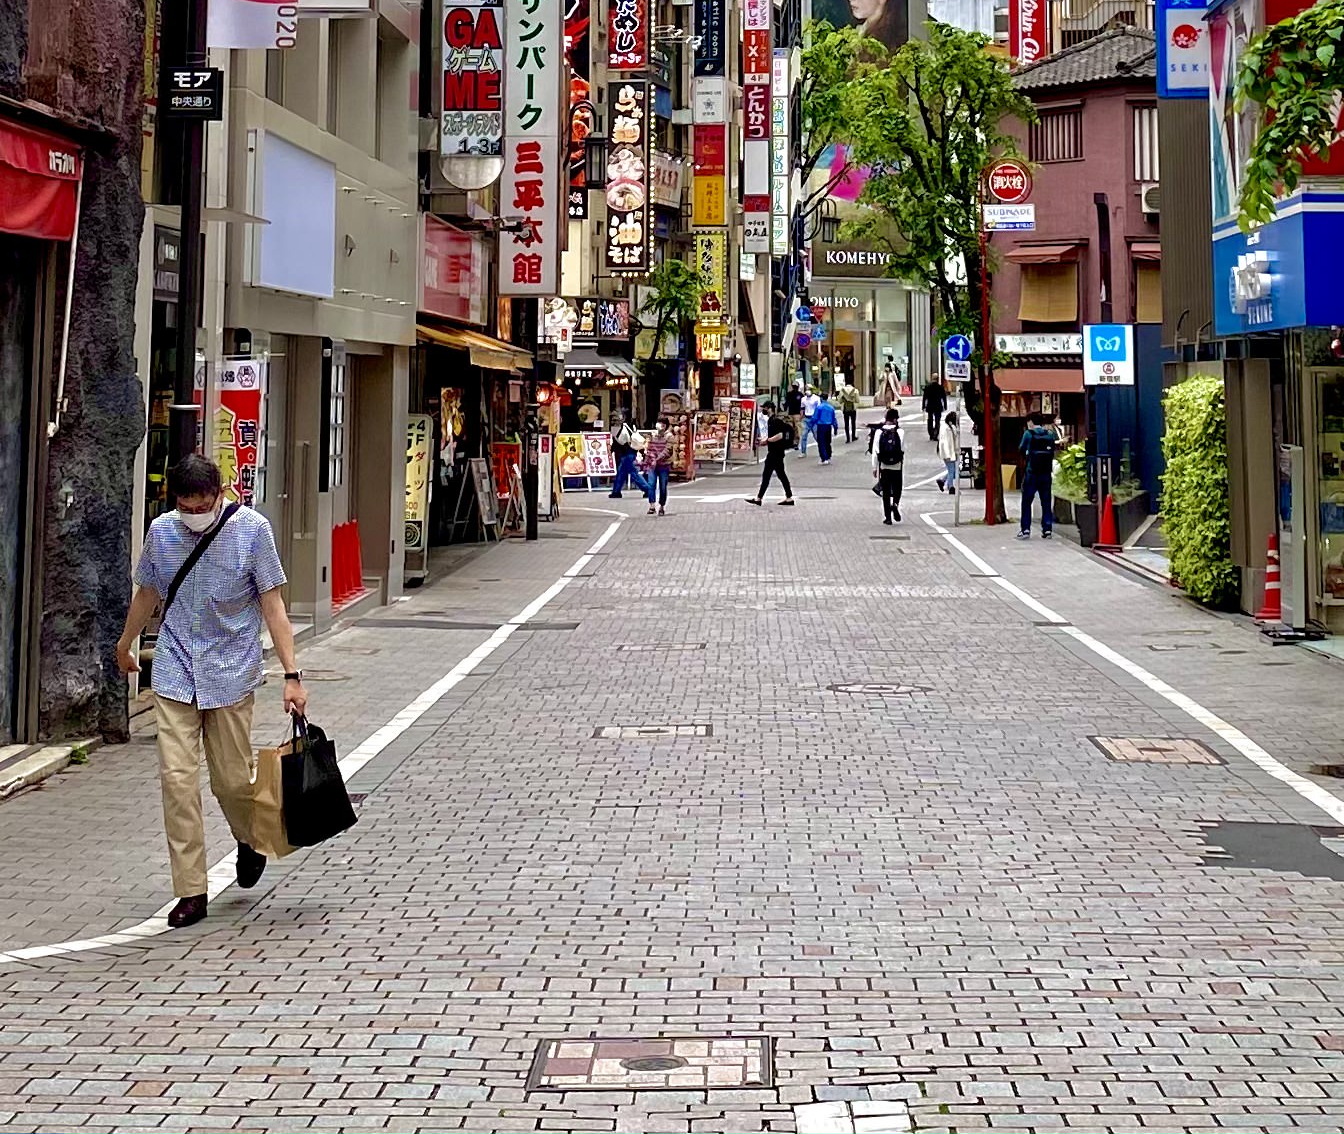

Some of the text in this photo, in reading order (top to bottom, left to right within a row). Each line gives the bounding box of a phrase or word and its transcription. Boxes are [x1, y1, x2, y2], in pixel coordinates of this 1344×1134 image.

[443, 7, 503, 50] GA
[446, 45, 498, 76] ゲーム
[173, 71, 213, 88] モア
[443, 69, 502, 112] ME
[170, 96, 213, 108] 中央通り
[747, 85, 766, 138] とんかつ
[442, 112, 501, 136] スポーツランド
[992, 174, 1024, 190] 消火栓
[511, 140, 545, 286] 三平本館
